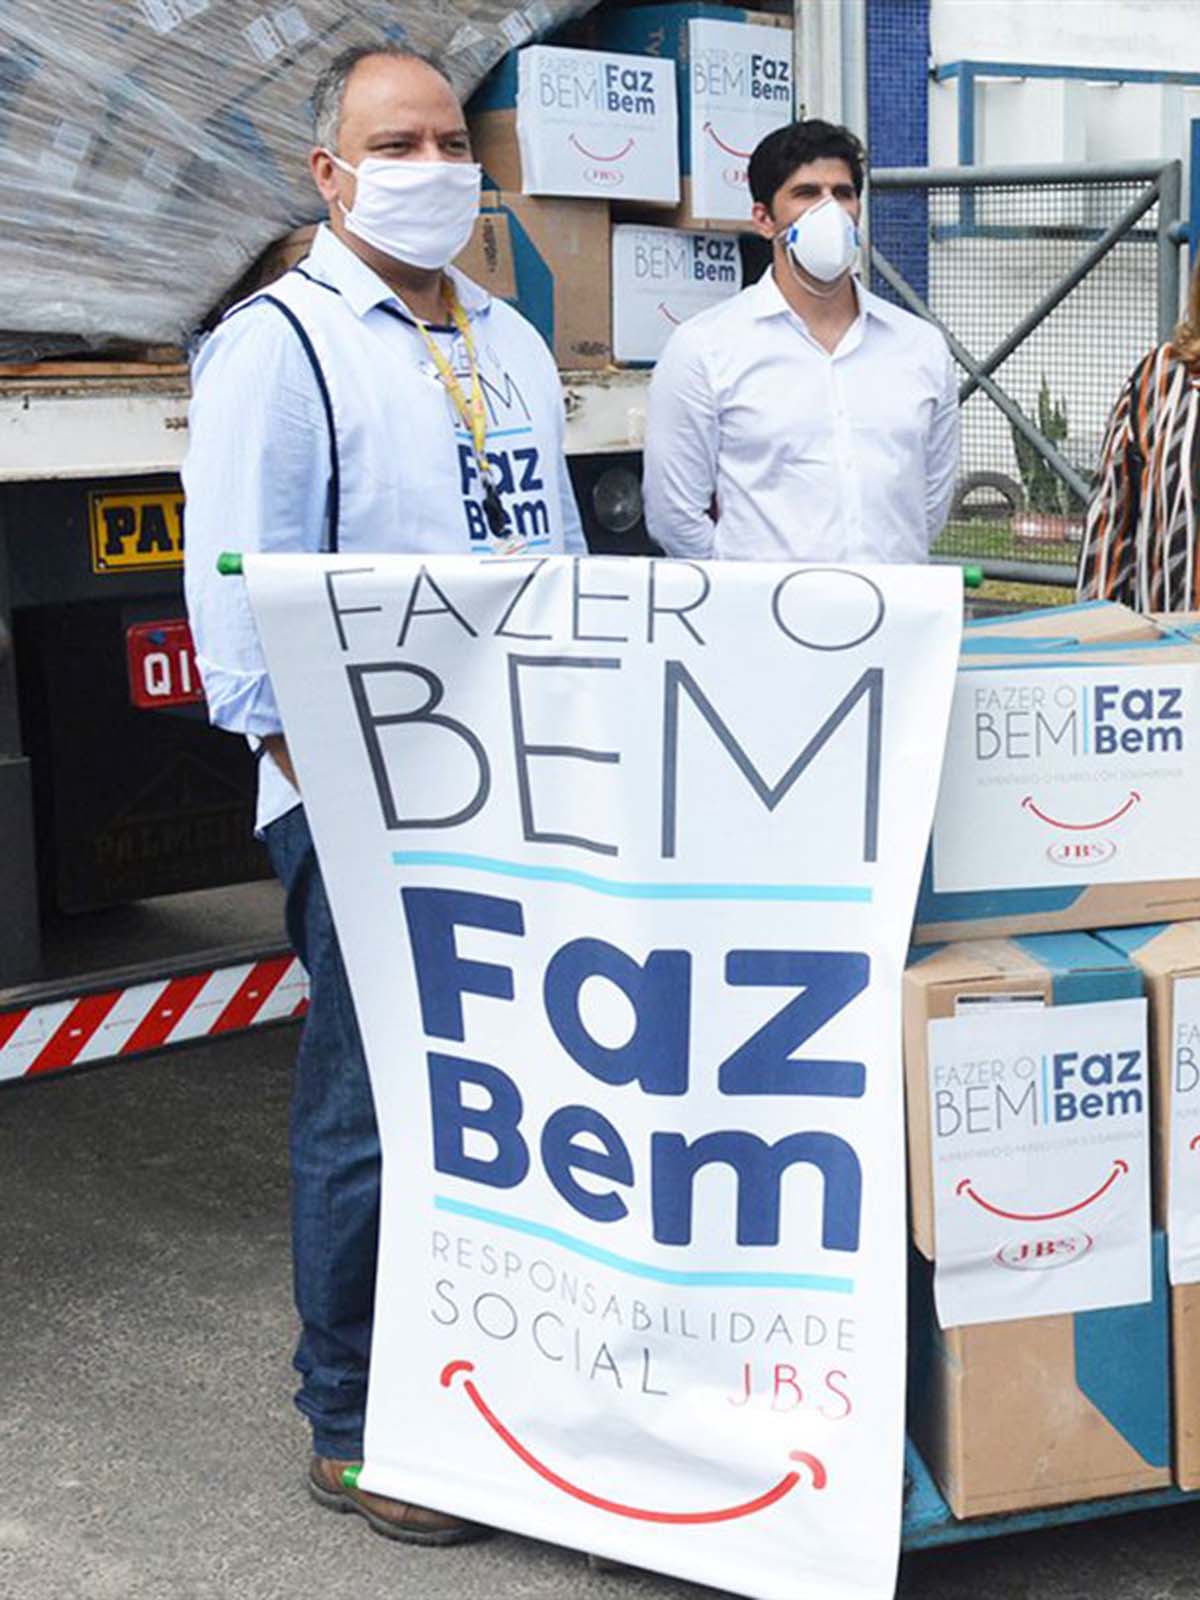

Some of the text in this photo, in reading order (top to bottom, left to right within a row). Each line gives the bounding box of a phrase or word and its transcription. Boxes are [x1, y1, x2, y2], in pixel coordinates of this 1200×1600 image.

[605, 63, 654, 94] Faz
[694, 63, 745, 97] BEM
[752, 54, 789, 82] Faz
[540, 74, 598, 110] BEM
[607, 91, 656, 115] Bem
[751, 80, 790, 102] Bem
[634, 246, 688, 280] BEM
[693, 235, 736, 262] Faz
[693, 260, 736, 283] Bem
[102, 503, 185, 556] PA
[325, 556, 886, 652] FAZER O
[975, 685, 1077, 711] FAZER O
[1094, 685, 1182, 722] Faz
[975, 710, 1077, 760] BEM
[1094, 724, 1183, 754] Bem
[345, 652, 885, 864] BEM
[400, 885, 871, 1099] Faz
[934, 1056, 1036, 1089] FAZER O
[1053, 1050, 1142, 1090] Faz
[936, 1080, 1038, 1138] BEM
[1054, 1088, 1143, 1123] Bem
[426, 1050, 863, 1253] Bem
[1011, 1237, 1076, 1262] JBS
[431, 1230, 857, 1354] RESPONSABILIDADE
[431, 1278, 854, 1422] SOCIAL JBS
